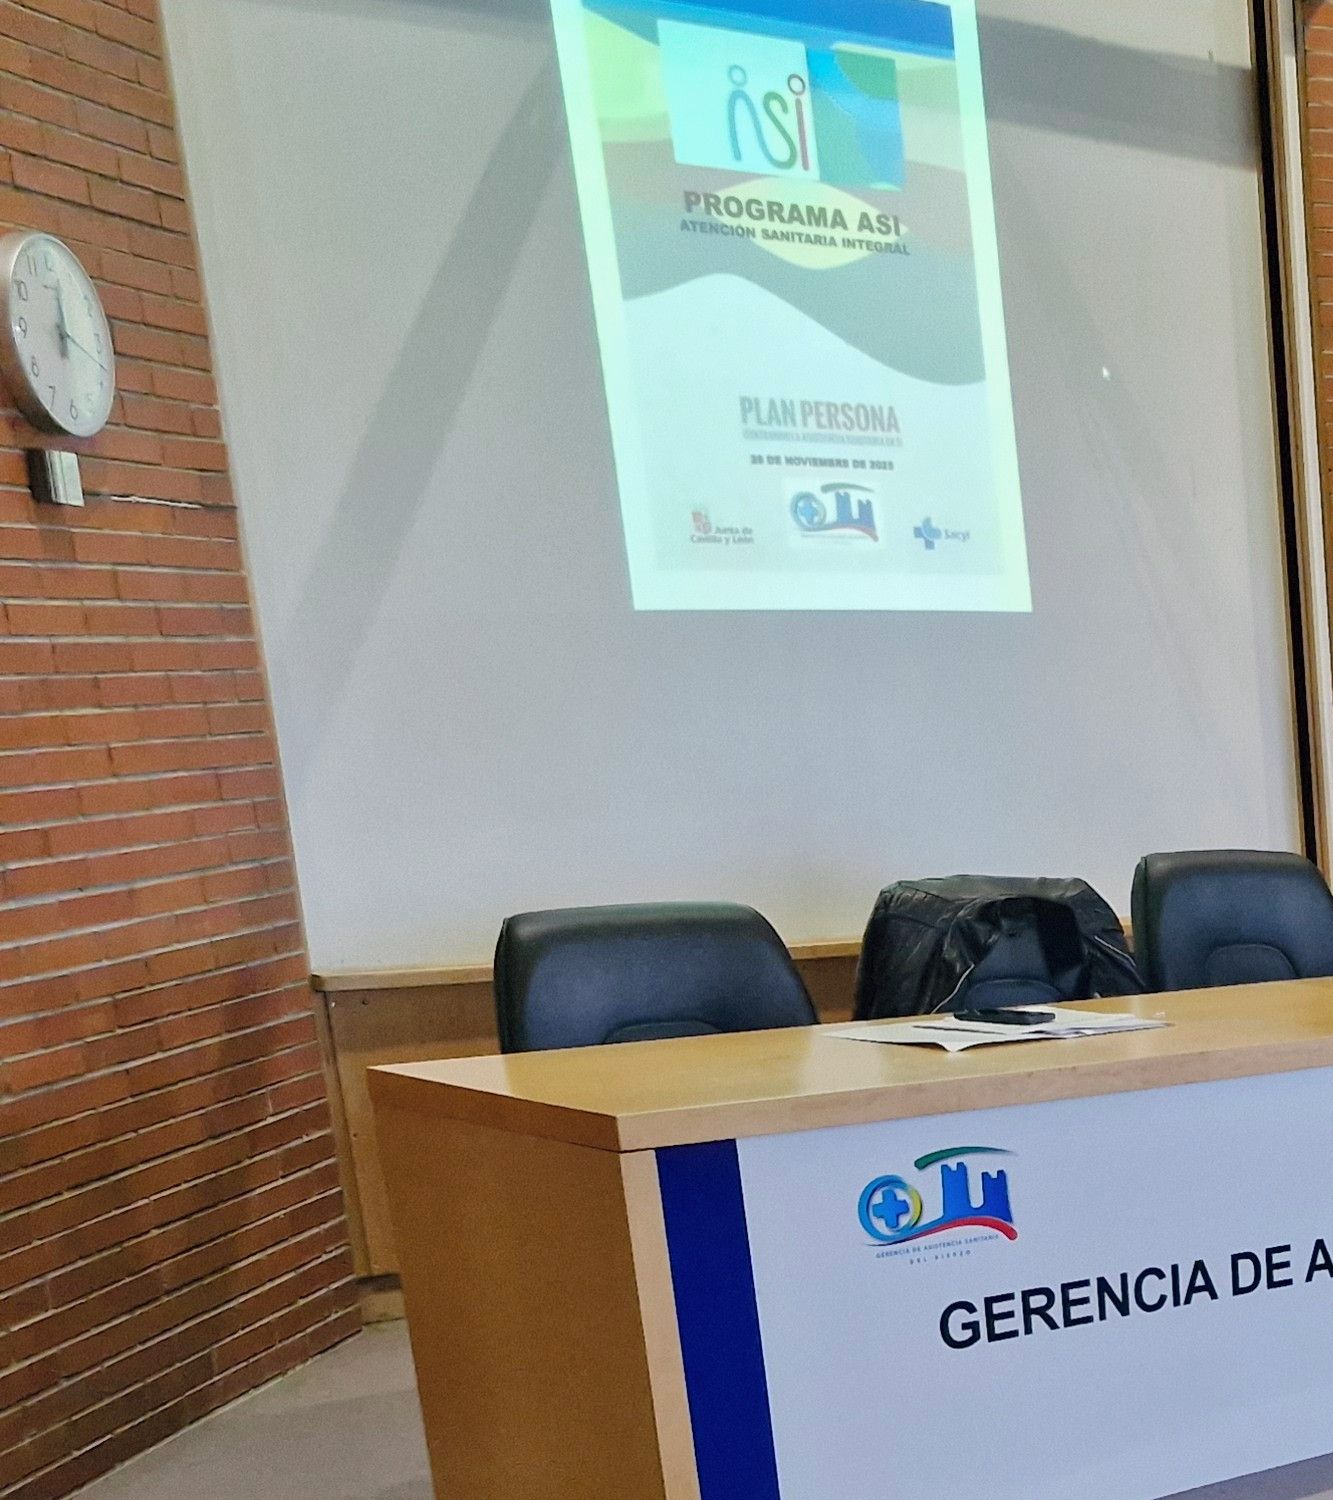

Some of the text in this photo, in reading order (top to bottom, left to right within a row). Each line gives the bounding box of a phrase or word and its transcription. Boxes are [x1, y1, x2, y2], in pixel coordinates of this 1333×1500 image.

[683, 190, 849, 231] PROGRAMA
[761, 228, 837, 248] SANITARIA
[842, 237, 911, 256] INTEGRAL
[69, 399, 79, 420] 6
[740, 396, 901, 433] PLAN PERSONA
[767, 455, 782, 466] DE
[785, 456, 850, 469] NOVIEMBRE
[853, 459, 867, 470] DE
[875, 1248, 910, 1259] GERENCIA
[924, 1240, 962, 1252] ASISTENCIA
[940, 1259, 1219, 1349] GERENCIA
[1230, 1244, 1293, 1296] DE
